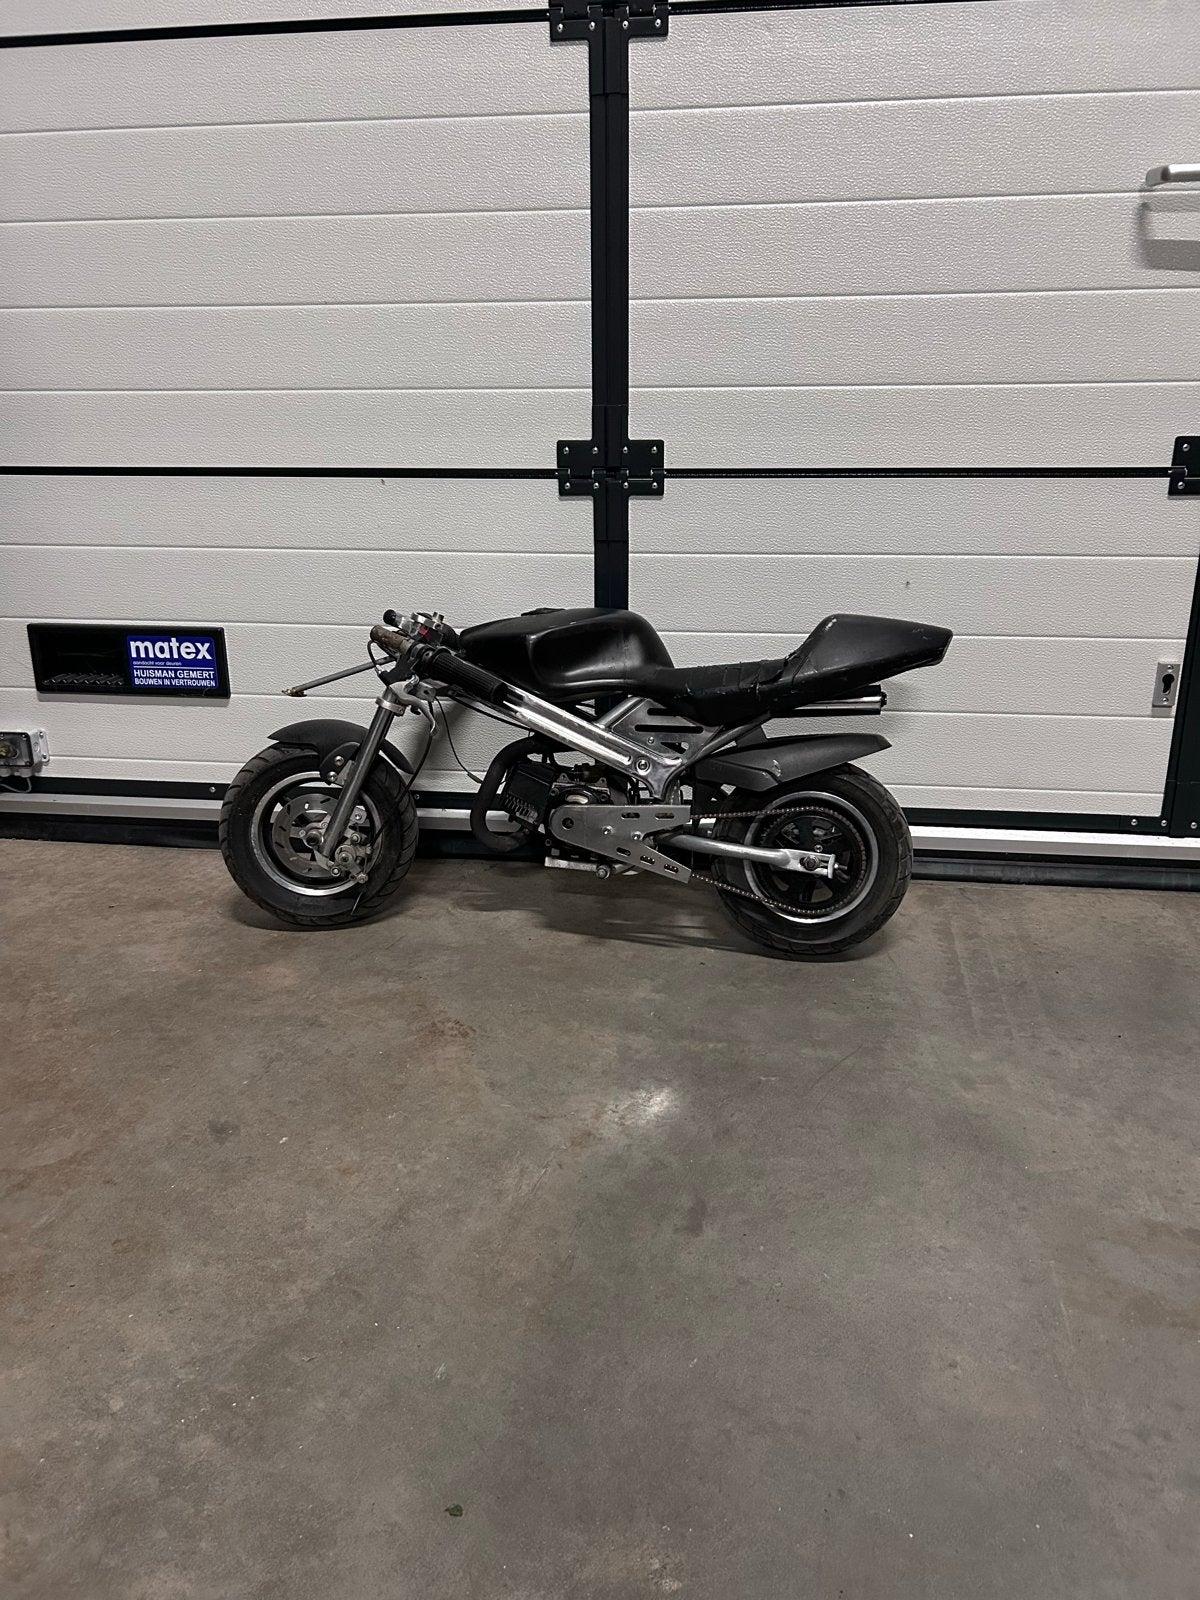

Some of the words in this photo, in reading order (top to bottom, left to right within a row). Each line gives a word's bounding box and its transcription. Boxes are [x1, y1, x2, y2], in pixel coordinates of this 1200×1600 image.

[130, 637, 212, 659] matex
[134, 669, 175, 678] HUISMAN
[177, 670, 214, 679] GEMERT
[135, 677, 163, 685] BOUWEN
[164, 678, 170, 686] IN
[172, 678, 215, 687] VERTROUWEN
